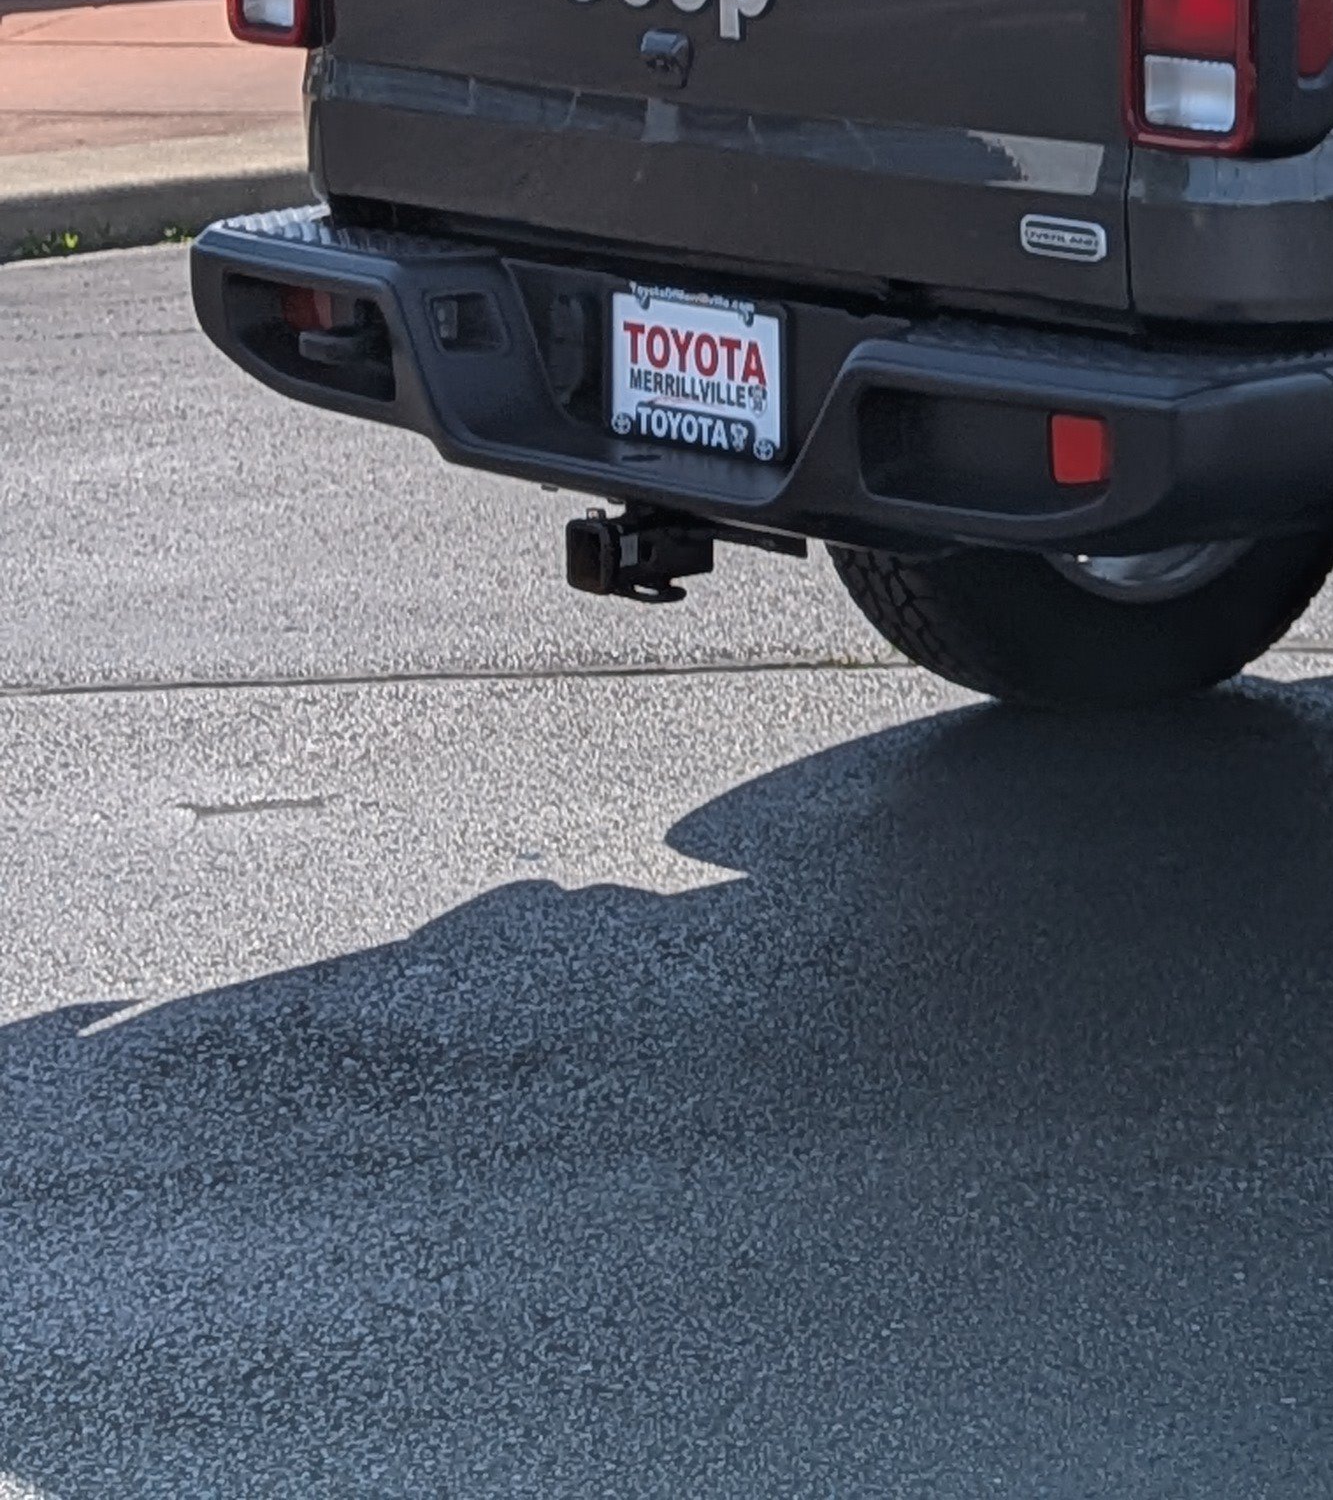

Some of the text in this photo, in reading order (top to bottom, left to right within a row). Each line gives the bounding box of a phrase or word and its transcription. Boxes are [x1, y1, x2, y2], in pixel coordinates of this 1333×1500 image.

[623, 321, 767, 387] TOYOTA
[630, 368, 747, 408] MERRILLVILLE
[637, 407, 730, 450] TOYOTA
